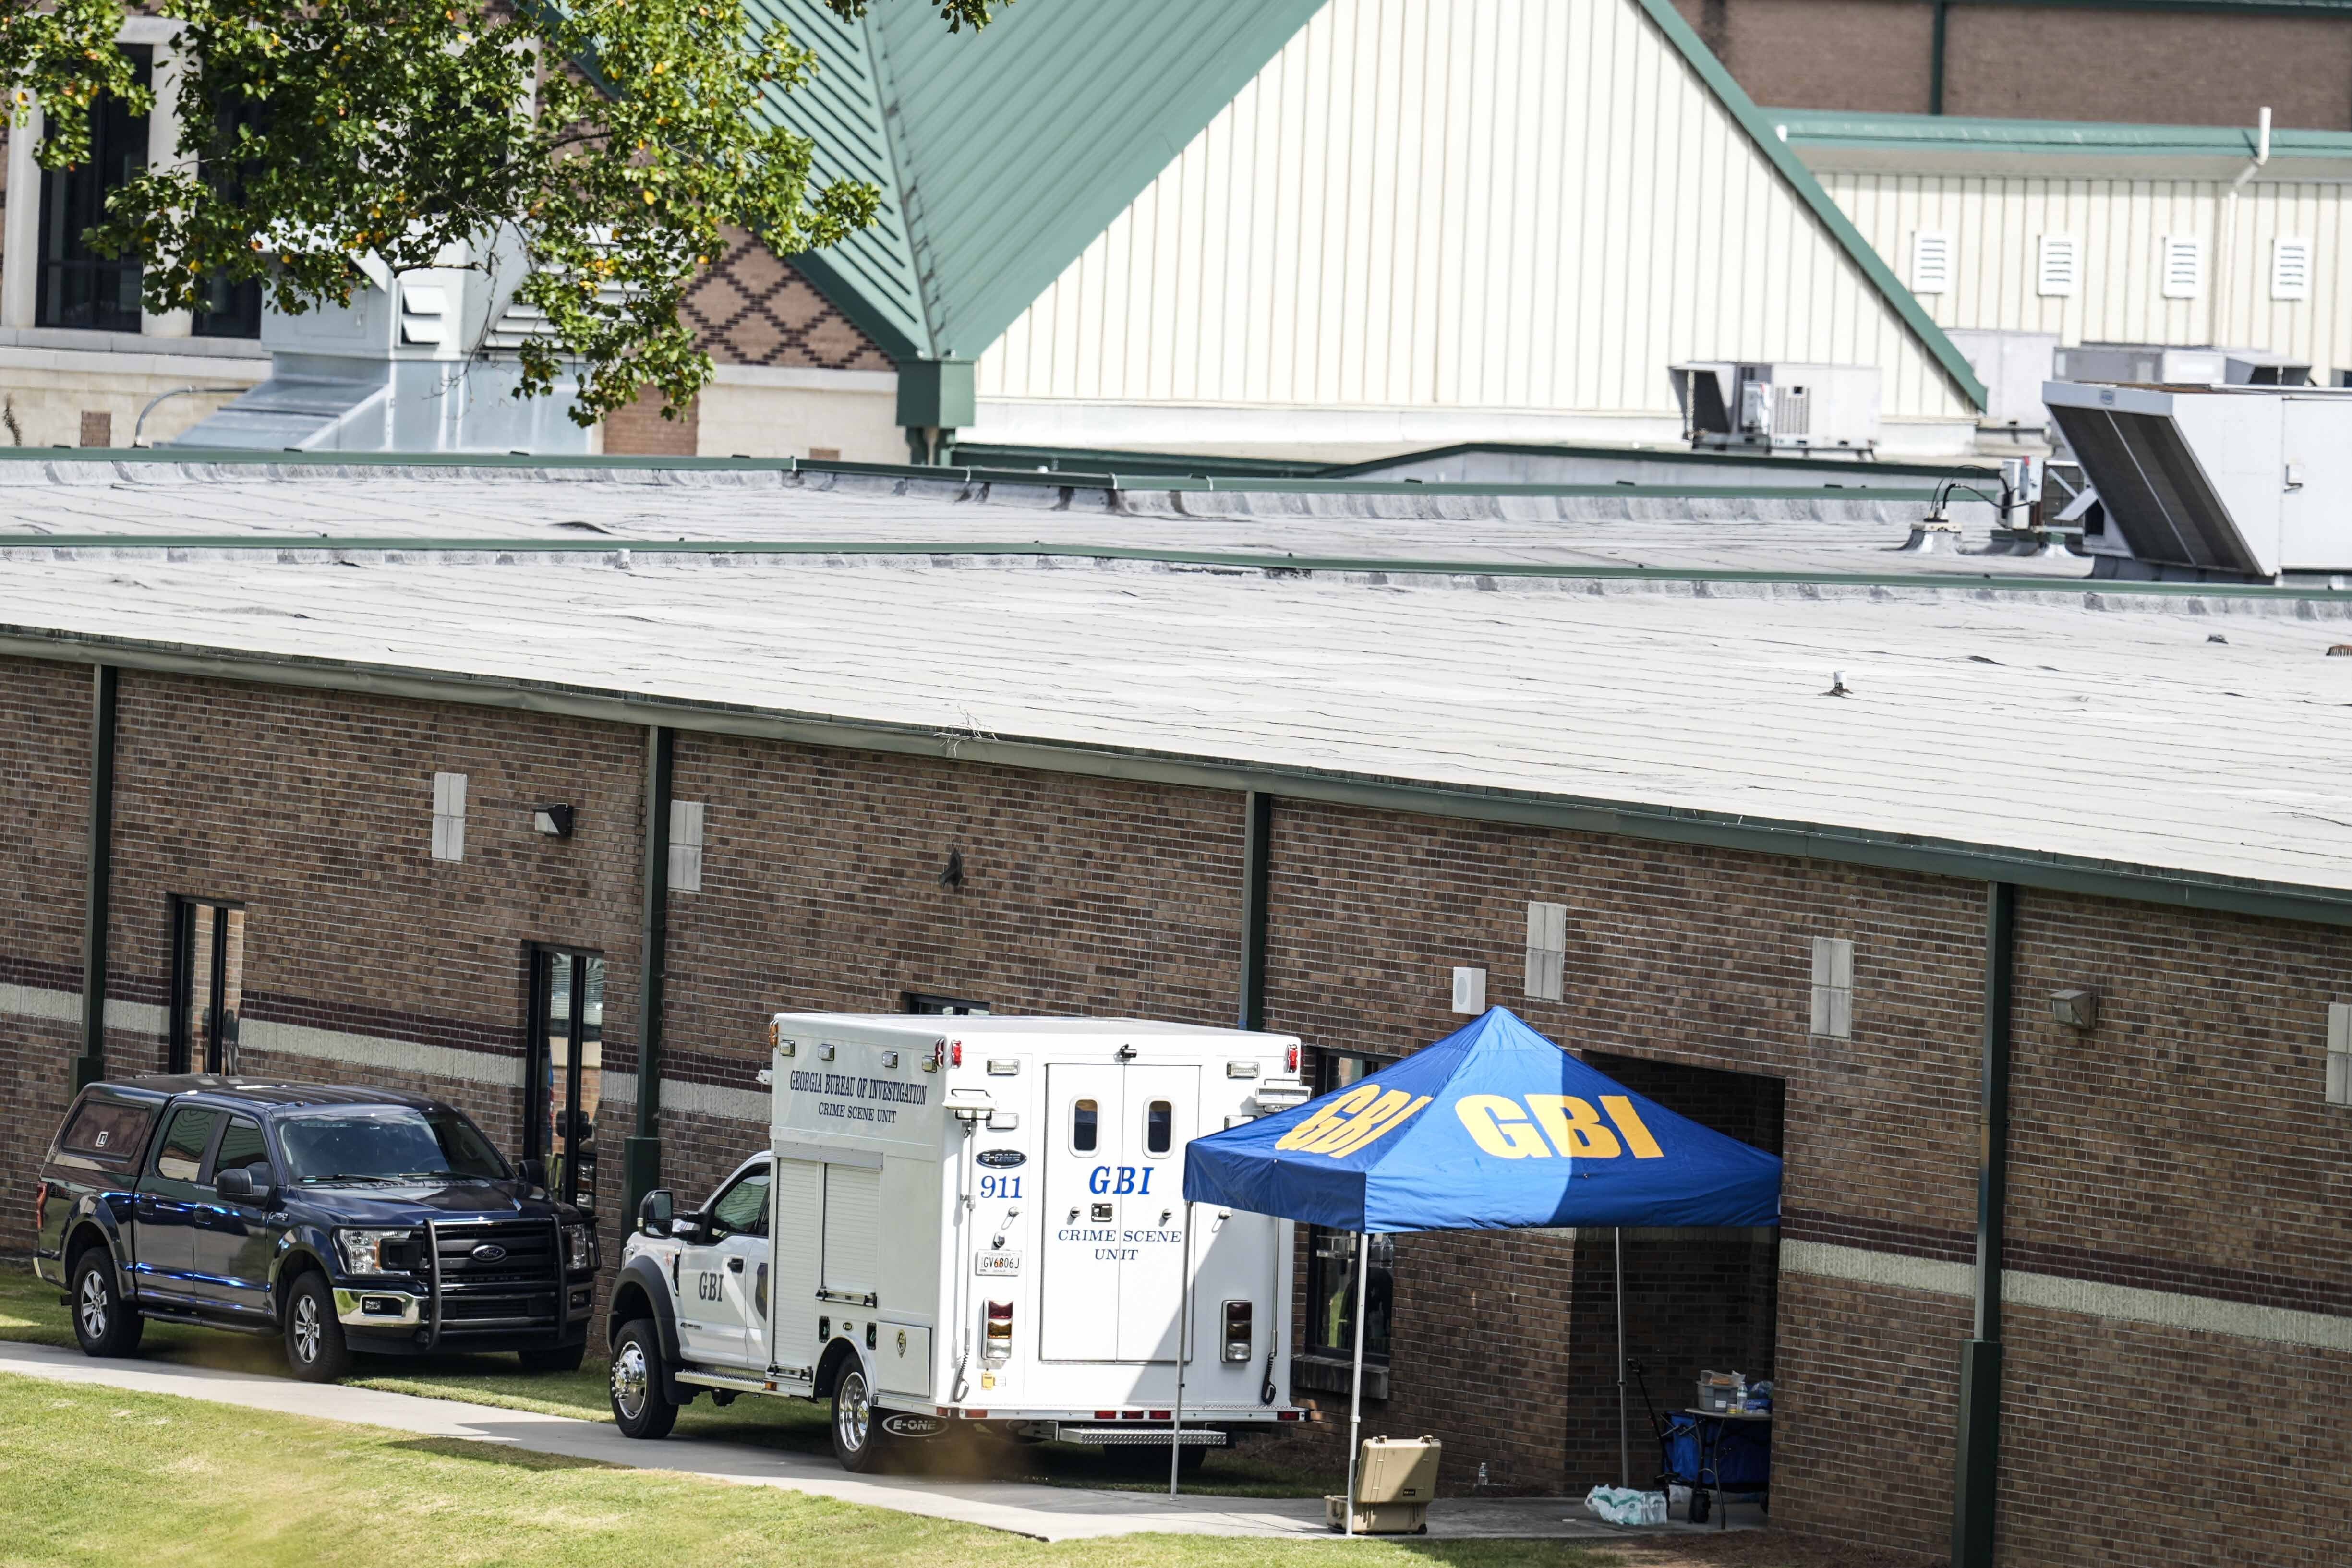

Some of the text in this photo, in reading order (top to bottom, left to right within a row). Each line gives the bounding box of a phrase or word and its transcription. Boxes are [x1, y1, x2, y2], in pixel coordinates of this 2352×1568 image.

[790, 1070, 927, 1105] GEORGIA BUREAU OF INVESTIGATION
[819, 1102, 897, 1123] CRIME SCENE UNIT
[1274, 1084, 1434, 1159] GBI
[1455, 1094, 1665, 1159] GBI
[980, 1175, 1022, 1198] 911
[1089, 1166, 1154, 1194] GBI
[1058, 1230, 1182, 1242] CRIME SCENE
[984, 1256, 1019, 1268] GV6806J
[1095, 1249, 1138, 1260] UNIT
[699, 1271, 724, 1302] GBI
[893, 1420, 936, 1430] E-ONE
